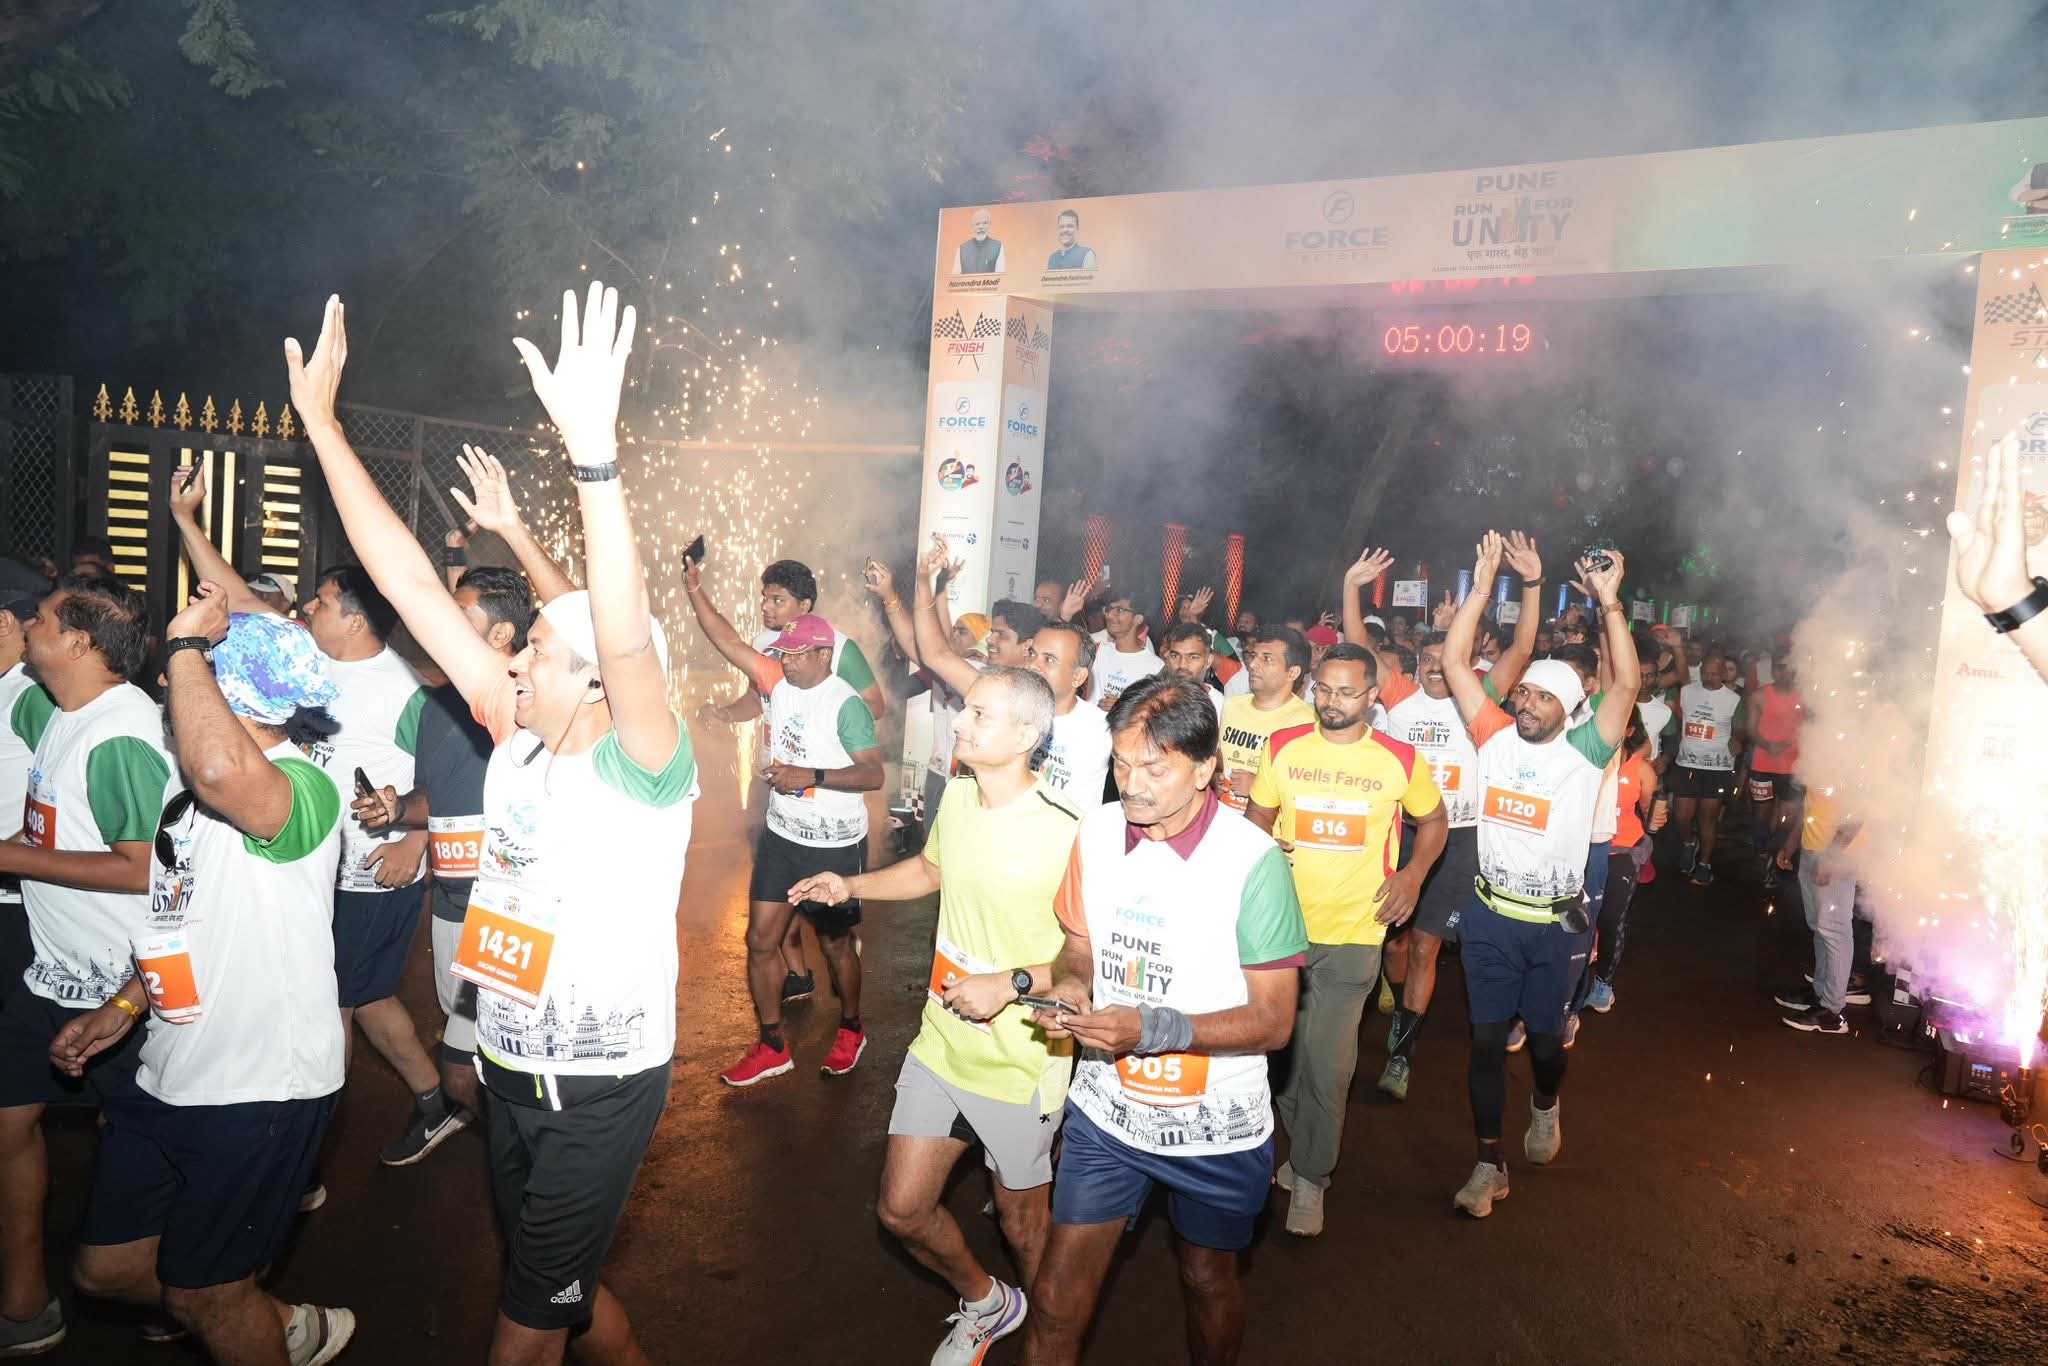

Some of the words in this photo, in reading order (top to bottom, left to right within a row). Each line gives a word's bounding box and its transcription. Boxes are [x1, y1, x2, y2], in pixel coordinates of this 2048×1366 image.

[1476, 170, 1559, 193] PUNE
[1454, 203, 1493, 217] RUN
[1534, 197, 1575, 211] FOR
[1285, 227, 1392, 248] FORCE
[949, 279, 981, 288] Narendra
[982, 277, 1001, 286] Modi
[947, 342, 985, 353] FINISH
[1384, 323, 1531, 353] 05:00:19
[939, 416, 986, 427] FORCE
[1007, 419, 1040, 436] FORCE
[1222, 725, 1261, 751] SHOW
[1054, 767, 1071, 778] FOR
[1288, 766, 1331, 783] Wells
[1336, 771, 1383, 792] Fargo
[1496, 795, 1537, 818] 1120
[1311, 818, 1348, 837] 816
[434, 840, 480, 860] 1803
[1115, 905, 1166, 928] FORCE
[478, 924, 534, 971] 1421
[1111, 931, 1162, 956] PUNE
[1101, 948, 1123, 963] RUN
[1148, 961, 1174, 975] FOR
[1125, 1055, 1183, 1082] 905
[551, 1294, 583, 1304] adidas
